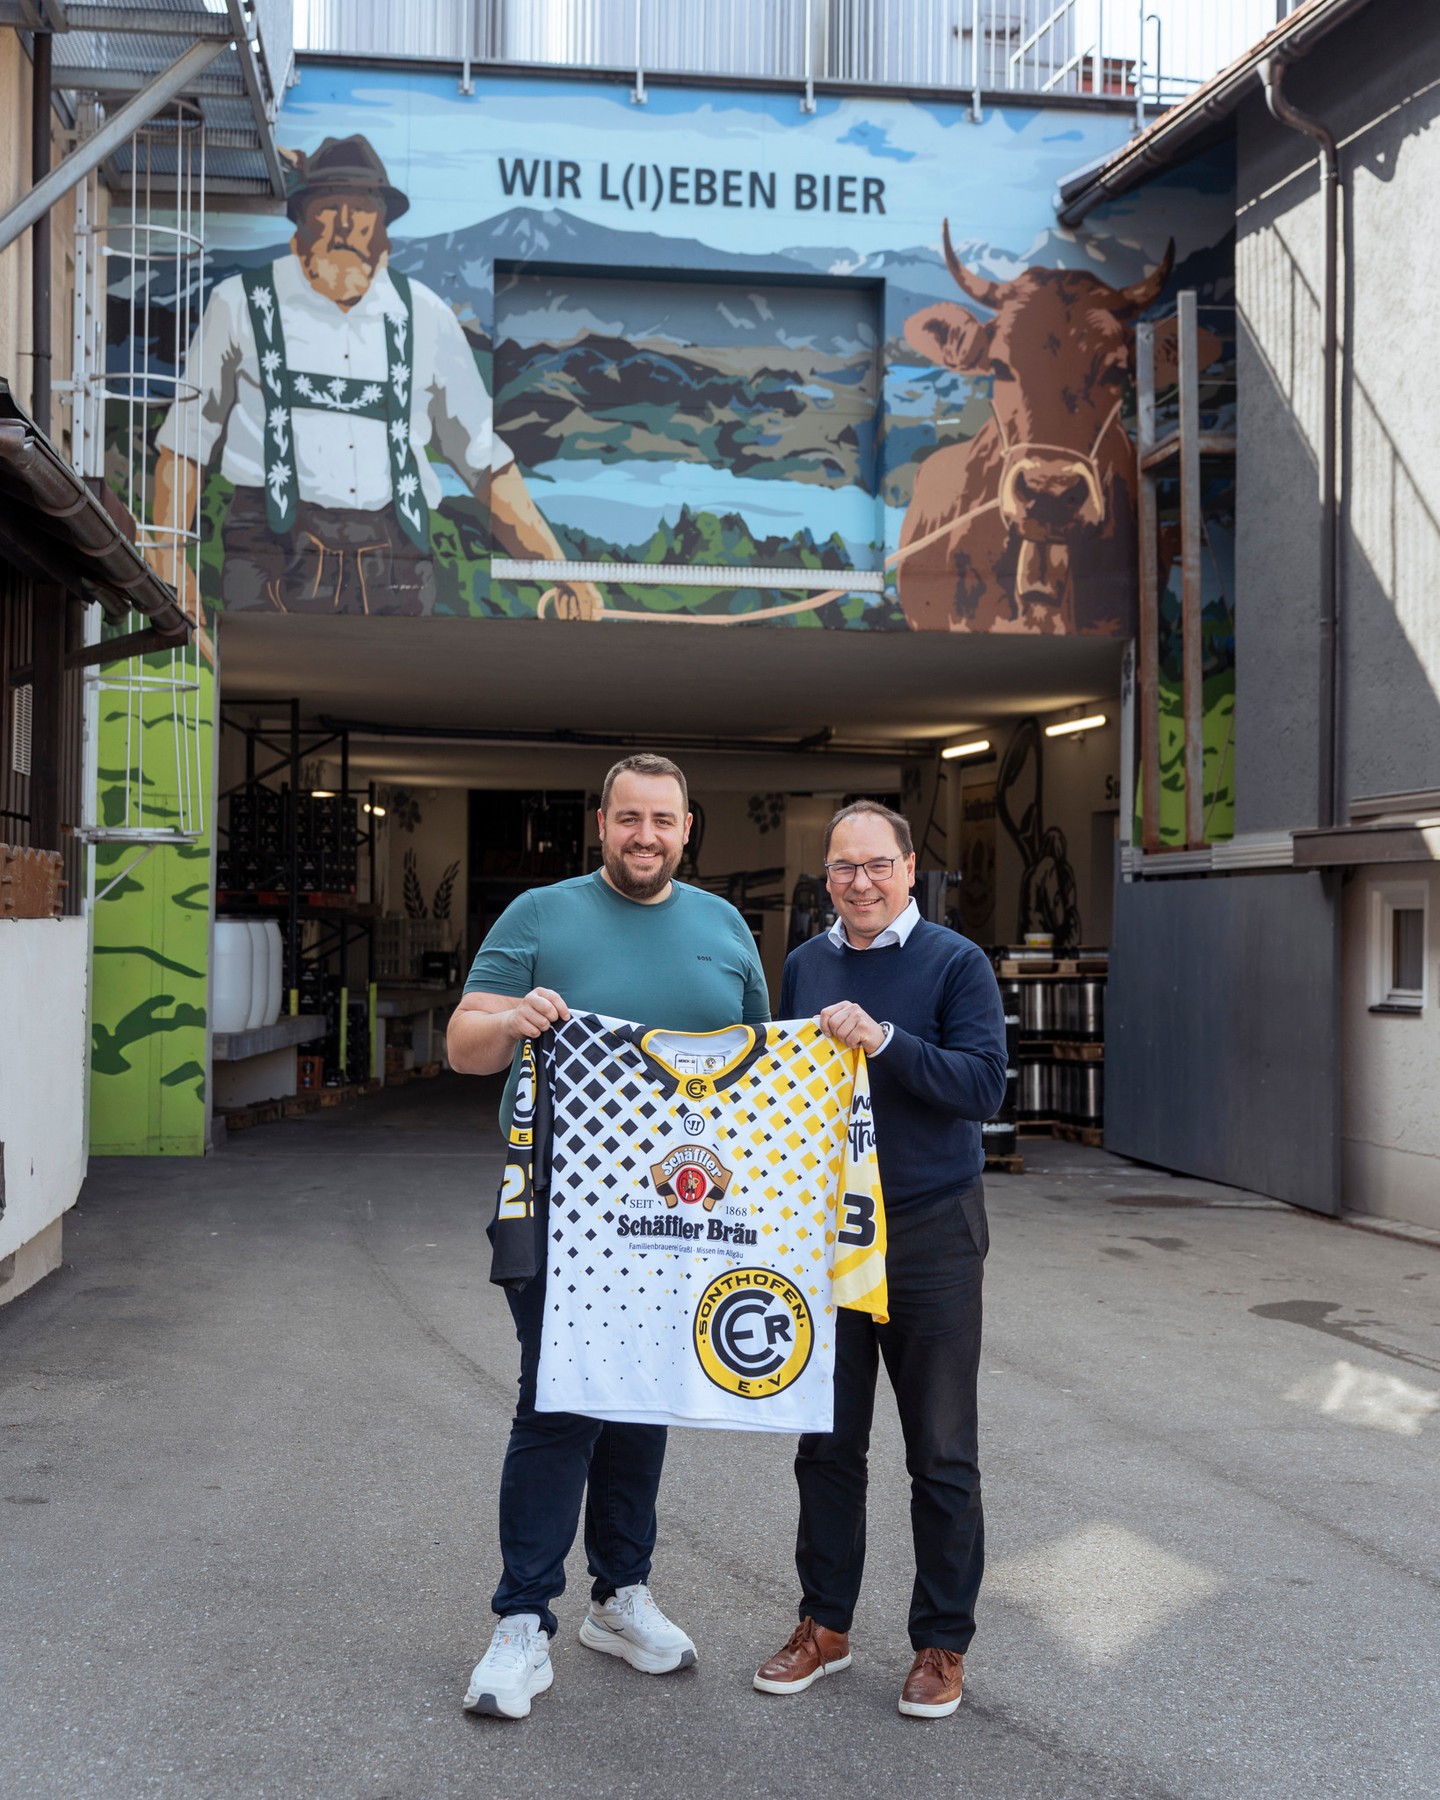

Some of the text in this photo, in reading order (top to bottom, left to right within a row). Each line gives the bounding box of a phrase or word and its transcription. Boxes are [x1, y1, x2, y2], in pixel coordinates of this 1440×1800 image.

[498, 158, 887, 215] WIR L(I)EBEN BIER
[661, 1148, 722, 1178] Schäffler
[498, 1163, 534, 1220] 2
[629, 1199, 748, 1217] SEIT 1868
[616, 1214, 758, 1247] Schäffler Bräu
[837, 1192, 876, 1248] 3
[628, 1242, 679, 1252] Familienbrauerei
[698, 1273, 807, 1336] SONTHOFEN
